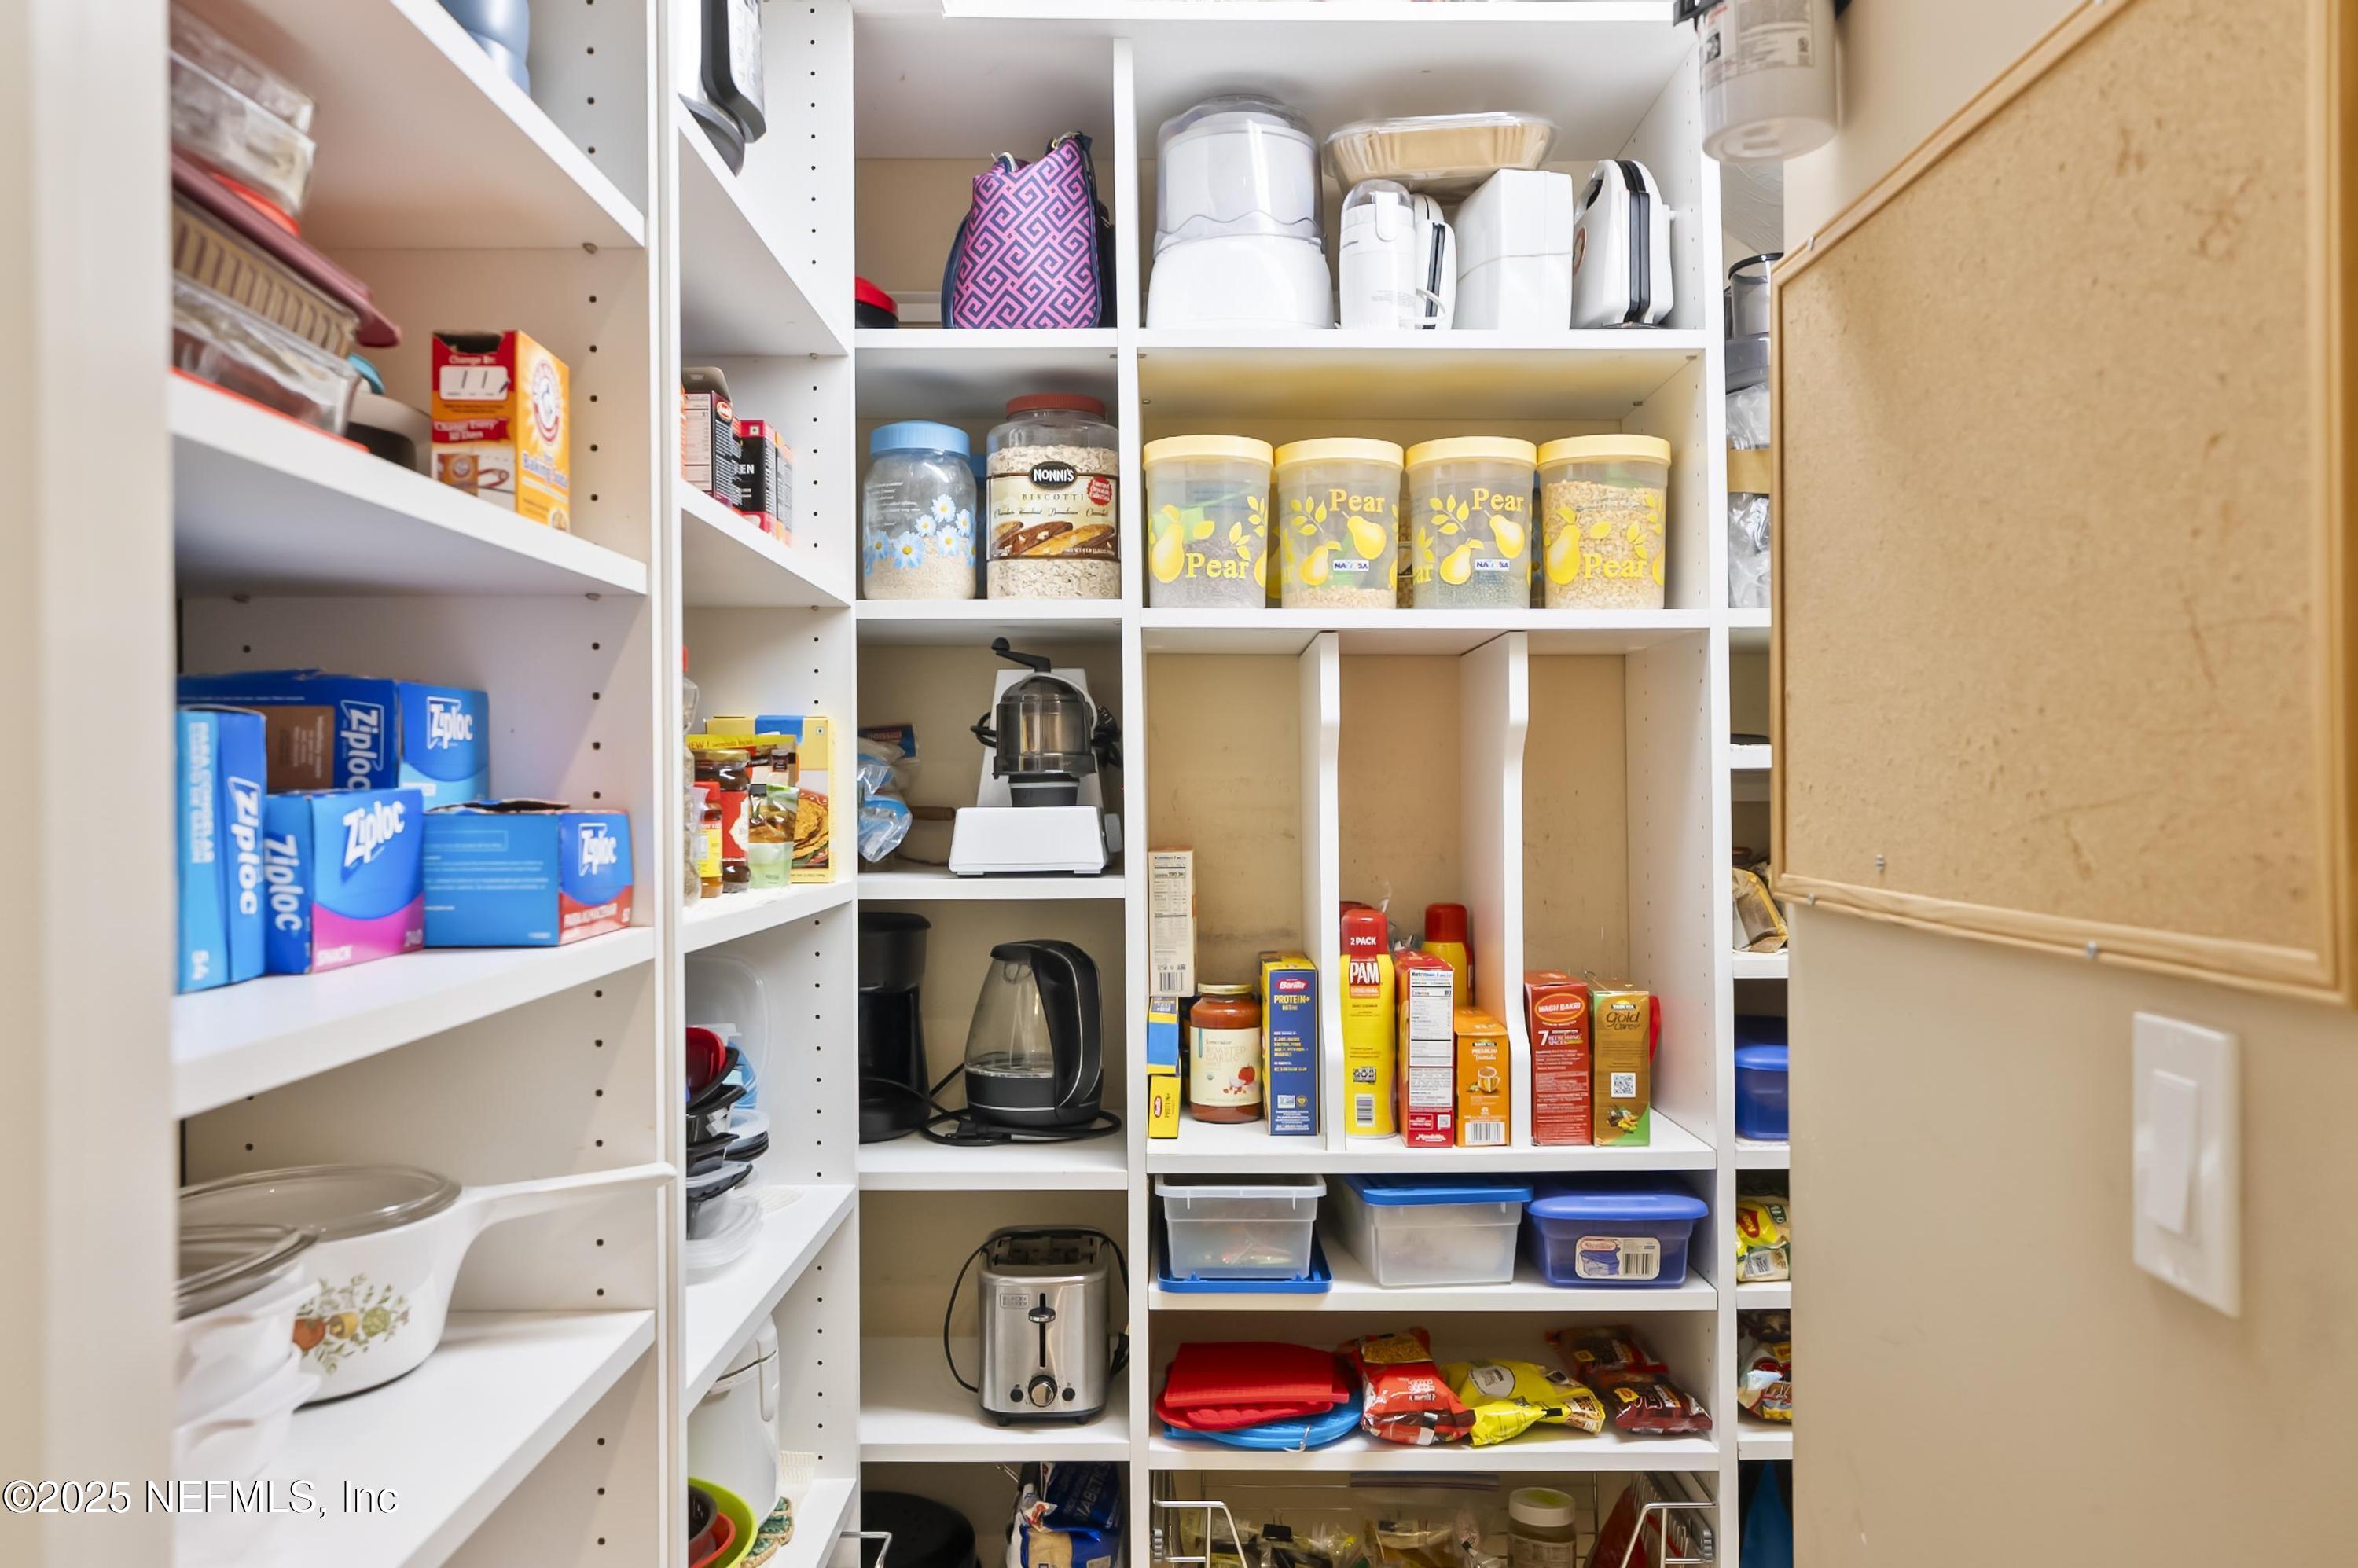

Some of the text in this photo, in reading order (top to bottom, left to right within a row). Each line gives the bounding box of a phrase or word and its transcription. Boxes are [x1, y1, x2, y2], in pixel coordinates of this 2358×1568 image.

[1033, 468, 1074, 482] NONNI'S
[1329, 489, 1385, 513] Pear
[1472, 488, 1524, 512] Pear
[1186, 553, 1248, 579] Pear
[1583, 554, 1647, 579] Pear
[430, 703, 473, 750] Ziploc
[340, 709, 379, 791] Ziploc
[343, 800, 406, 868] Ziploc
[230, 788, 262, 916] Ziploc
[580, 829, 617, 876] Ziploc
[265, 834, 304, 932] Ziploc
[1356, 937, 1377, 946] PACK
[1350, 962, 1379, 984] PAM
[1279, 981, 1306, 990] Barilla
[1274, 995, 1310, 1004] PROTEIN+
[1537, 1030, 1549, 1046] 7
